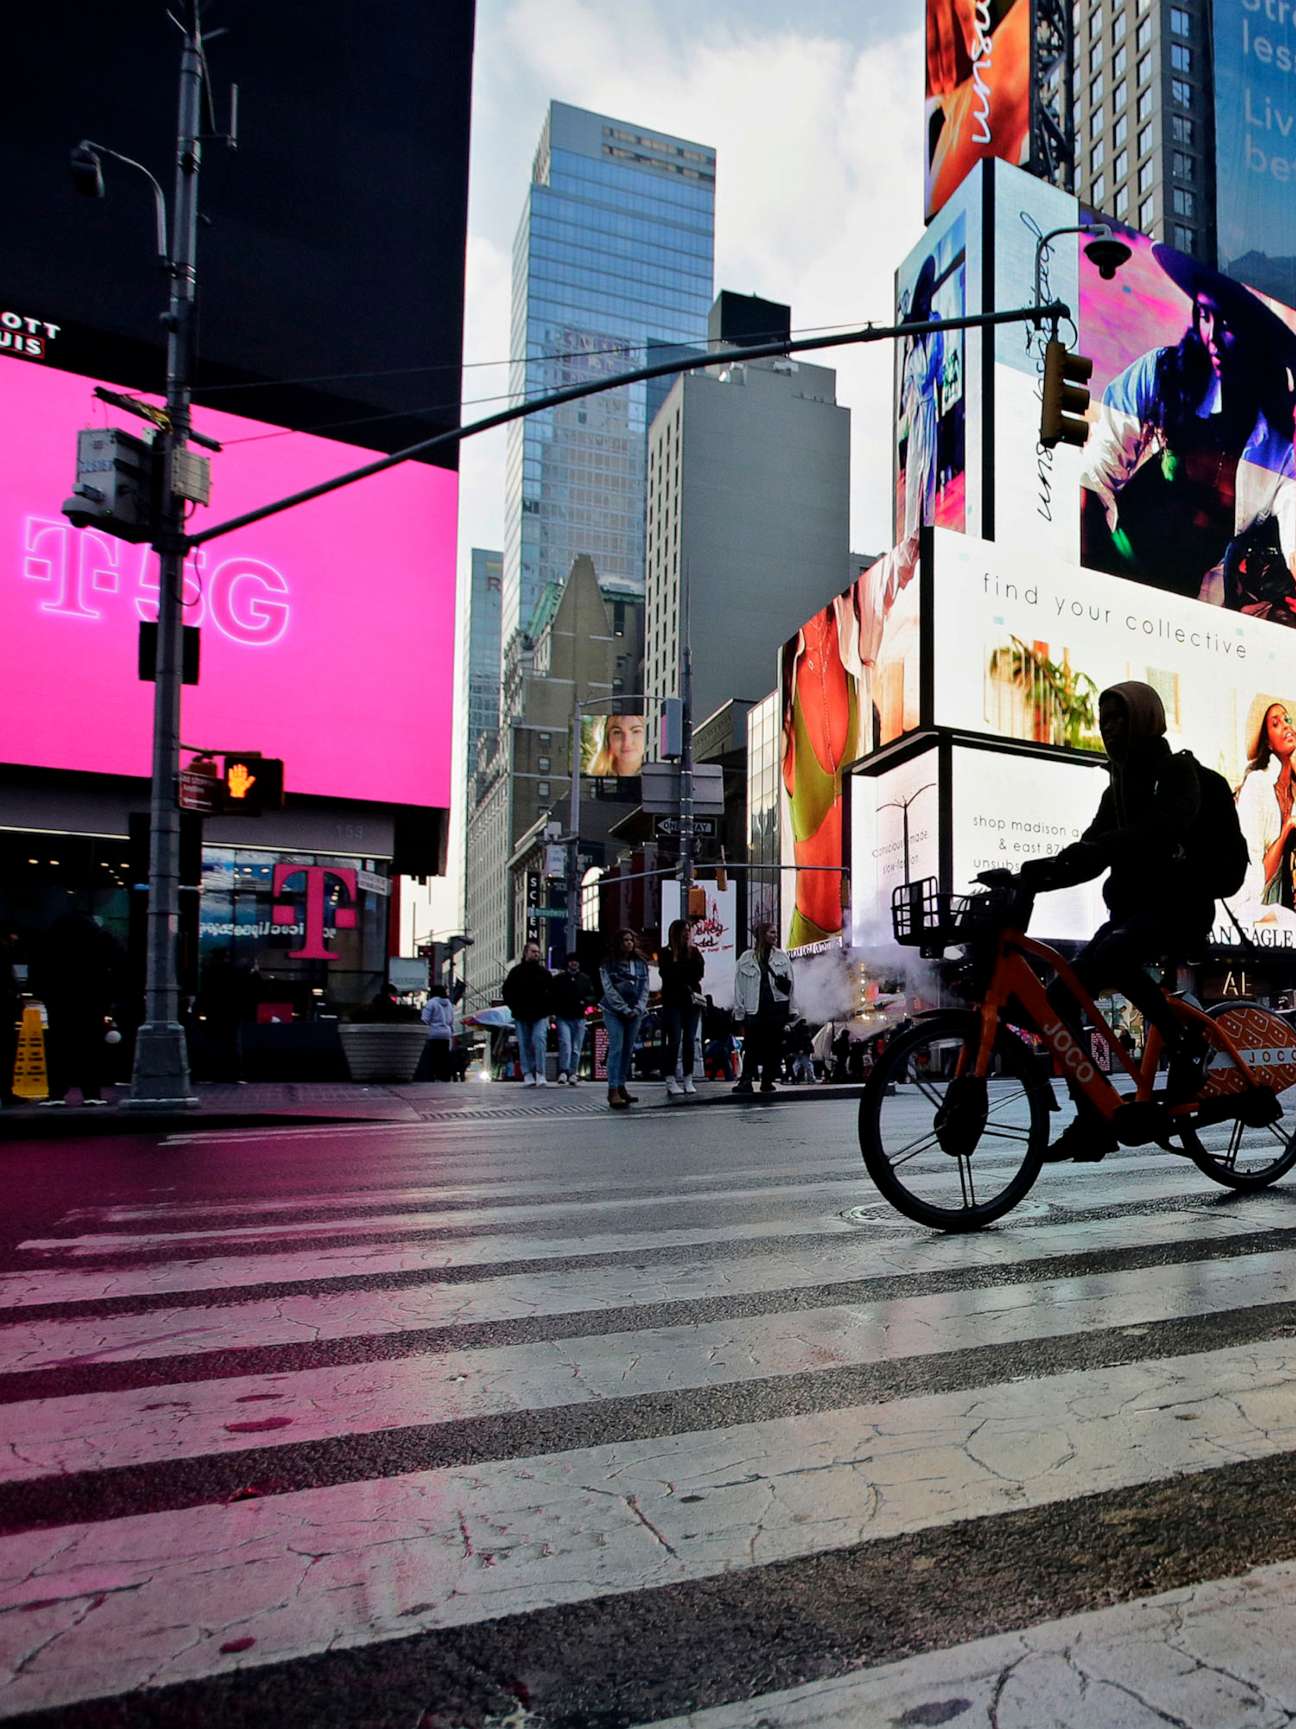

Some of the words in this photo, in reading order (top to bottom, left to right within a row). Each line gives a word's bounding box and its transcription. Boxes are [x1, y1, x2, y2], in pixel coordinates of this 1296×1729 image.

[983, 571, 1038, 606] find
[1055, 594, 1111, 627] your
[1125, 609, 1247, 660] collective
[973, 815, 1006, 831] shop
[1011, 820, 1066, 836] madison
[998, 838, 1007, 850] &
[1013, 841, 1041, 854] east
[1043, 1022, 1094, 1083] JOCO
